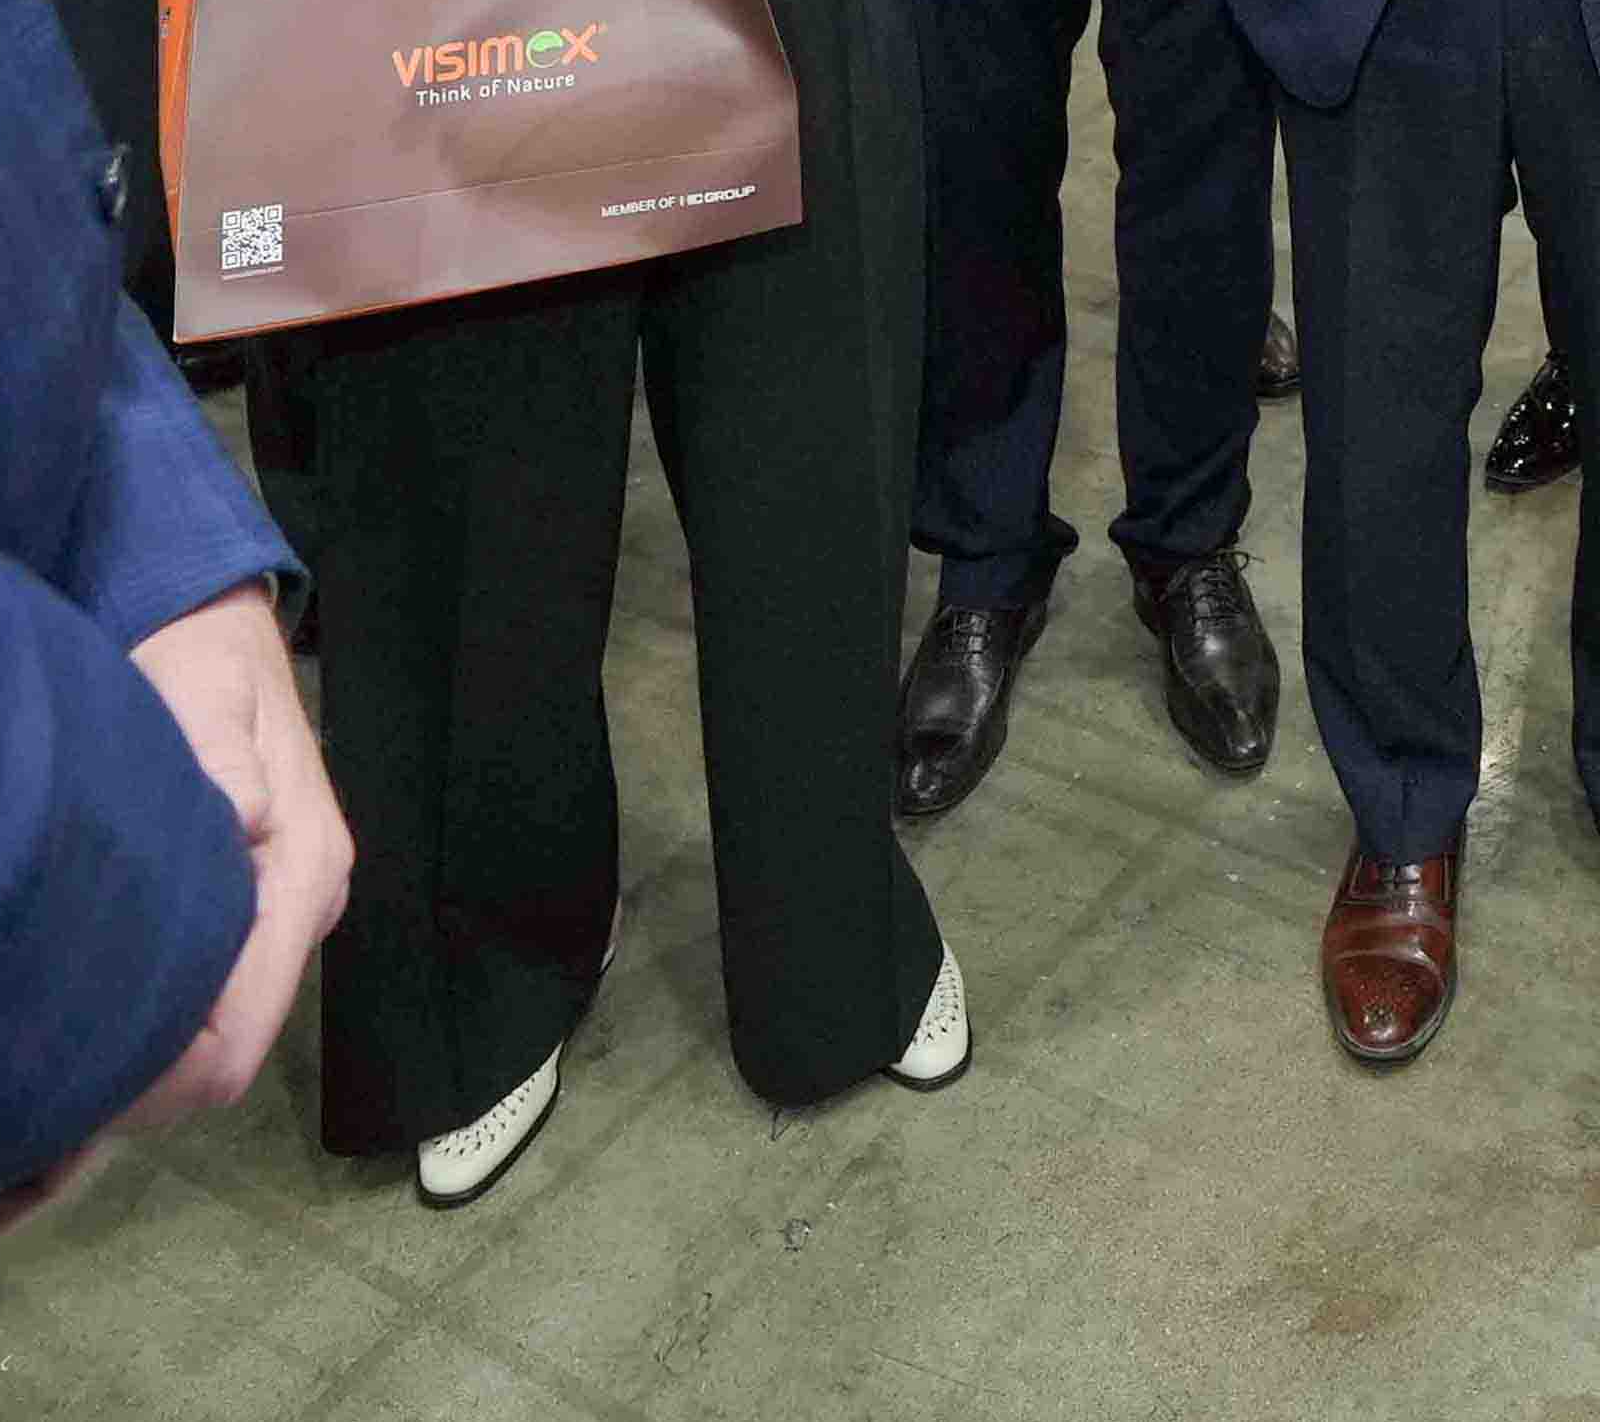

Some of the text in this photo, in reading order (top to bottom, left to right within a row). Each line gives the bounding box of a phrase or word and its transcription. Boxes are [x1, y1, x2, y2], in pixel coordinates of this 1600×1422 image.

[416, 84, 472, 107] Think
[506, 72, 576, 96] Nature
[601, 198, 656, 219] MEMBER
[658, 195, 677, 210] OF
